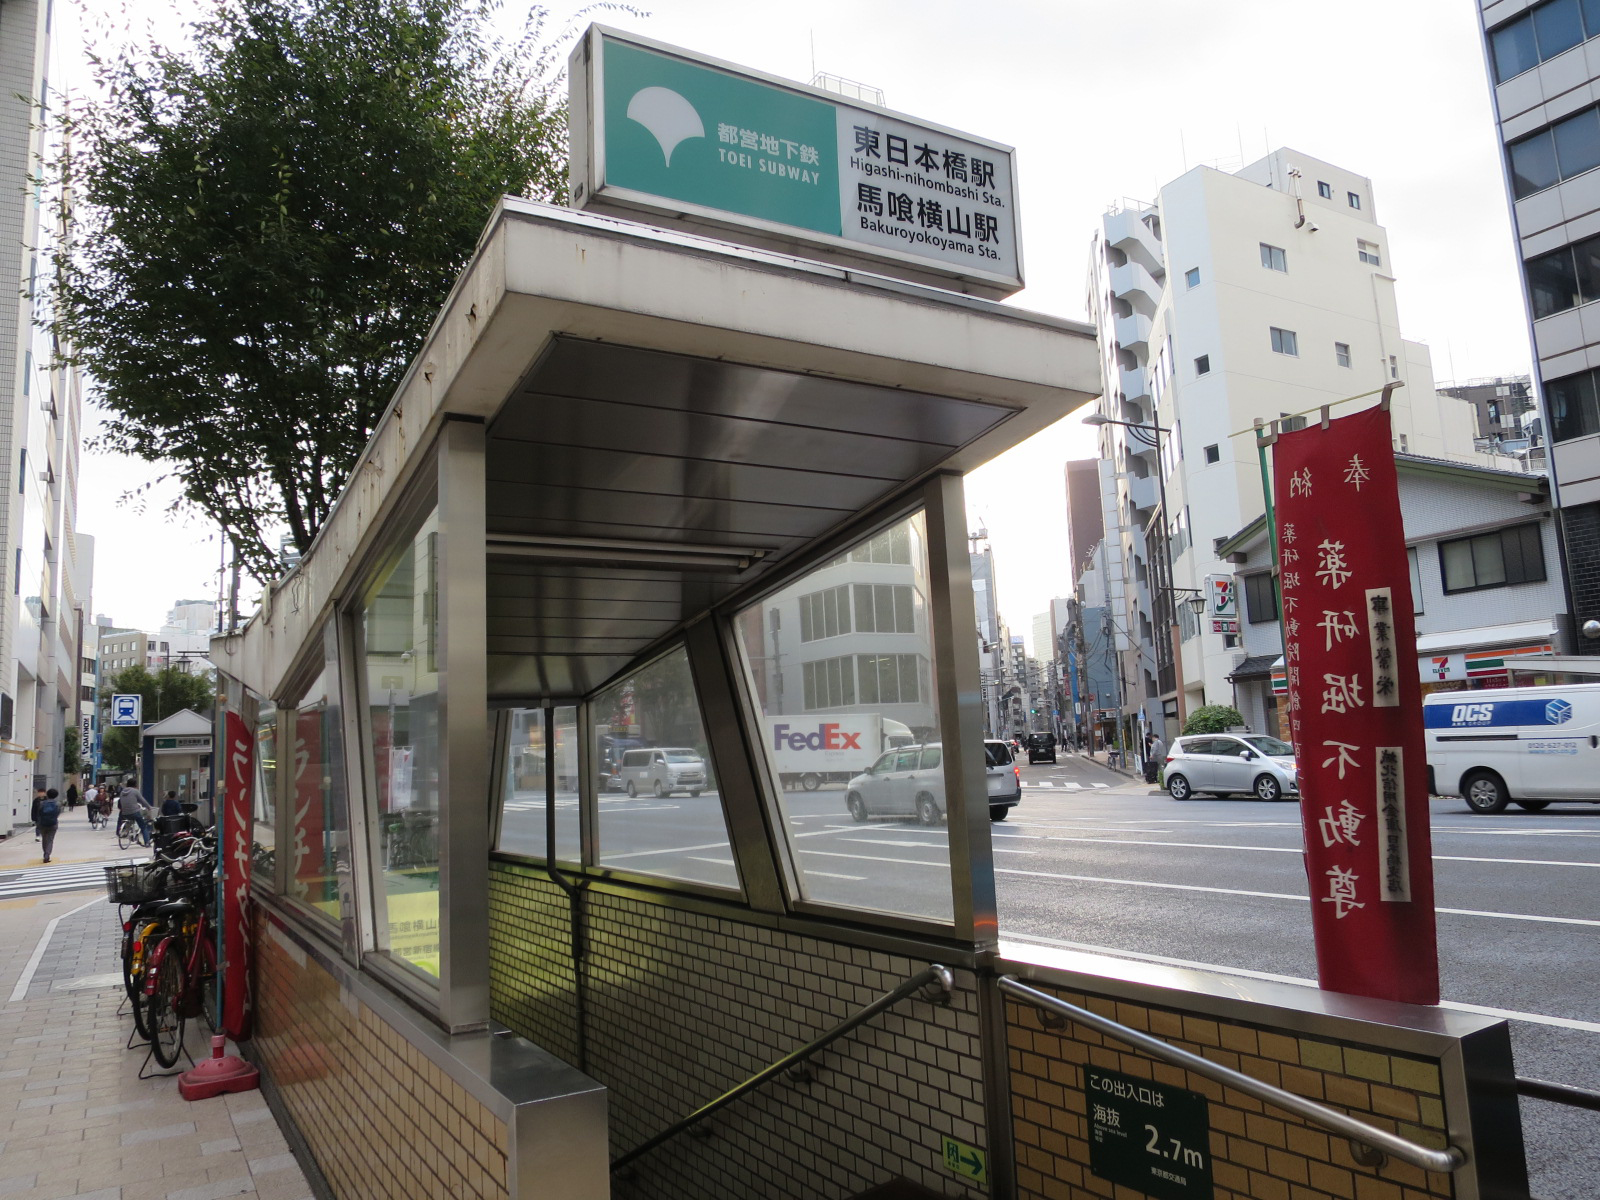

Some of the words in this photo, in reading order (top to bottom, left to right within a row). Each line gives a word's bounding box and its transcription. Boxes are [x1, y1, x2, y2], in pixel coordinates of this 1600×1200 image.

[718, 122, 819, 166] 都営地下鉄
[853, 125, 996, 190] 東日本橋駅
[719, 148, 752, 169] TOEI
[758, 158, 820, 185] SUBWAY
[850, 156, 979, 202] Higashi-nihombashi
[982, 192, 1005, 208] Sta.
[857, 182, 999, 245] 馬喰横山駅
[860, 216, 974, 254] Bakuroyokoyama
[978, 244, 1001, 260] Sta.
[1451, 703, 1494, 722] OCS
[774, 723, 861, 751] FedEx
[1090, 1074, 1165, 1107] この出入口は
[1093, 1103, 1121, 1128] 海抜
[1144, 1124, 1203, 1170] 2.7m
